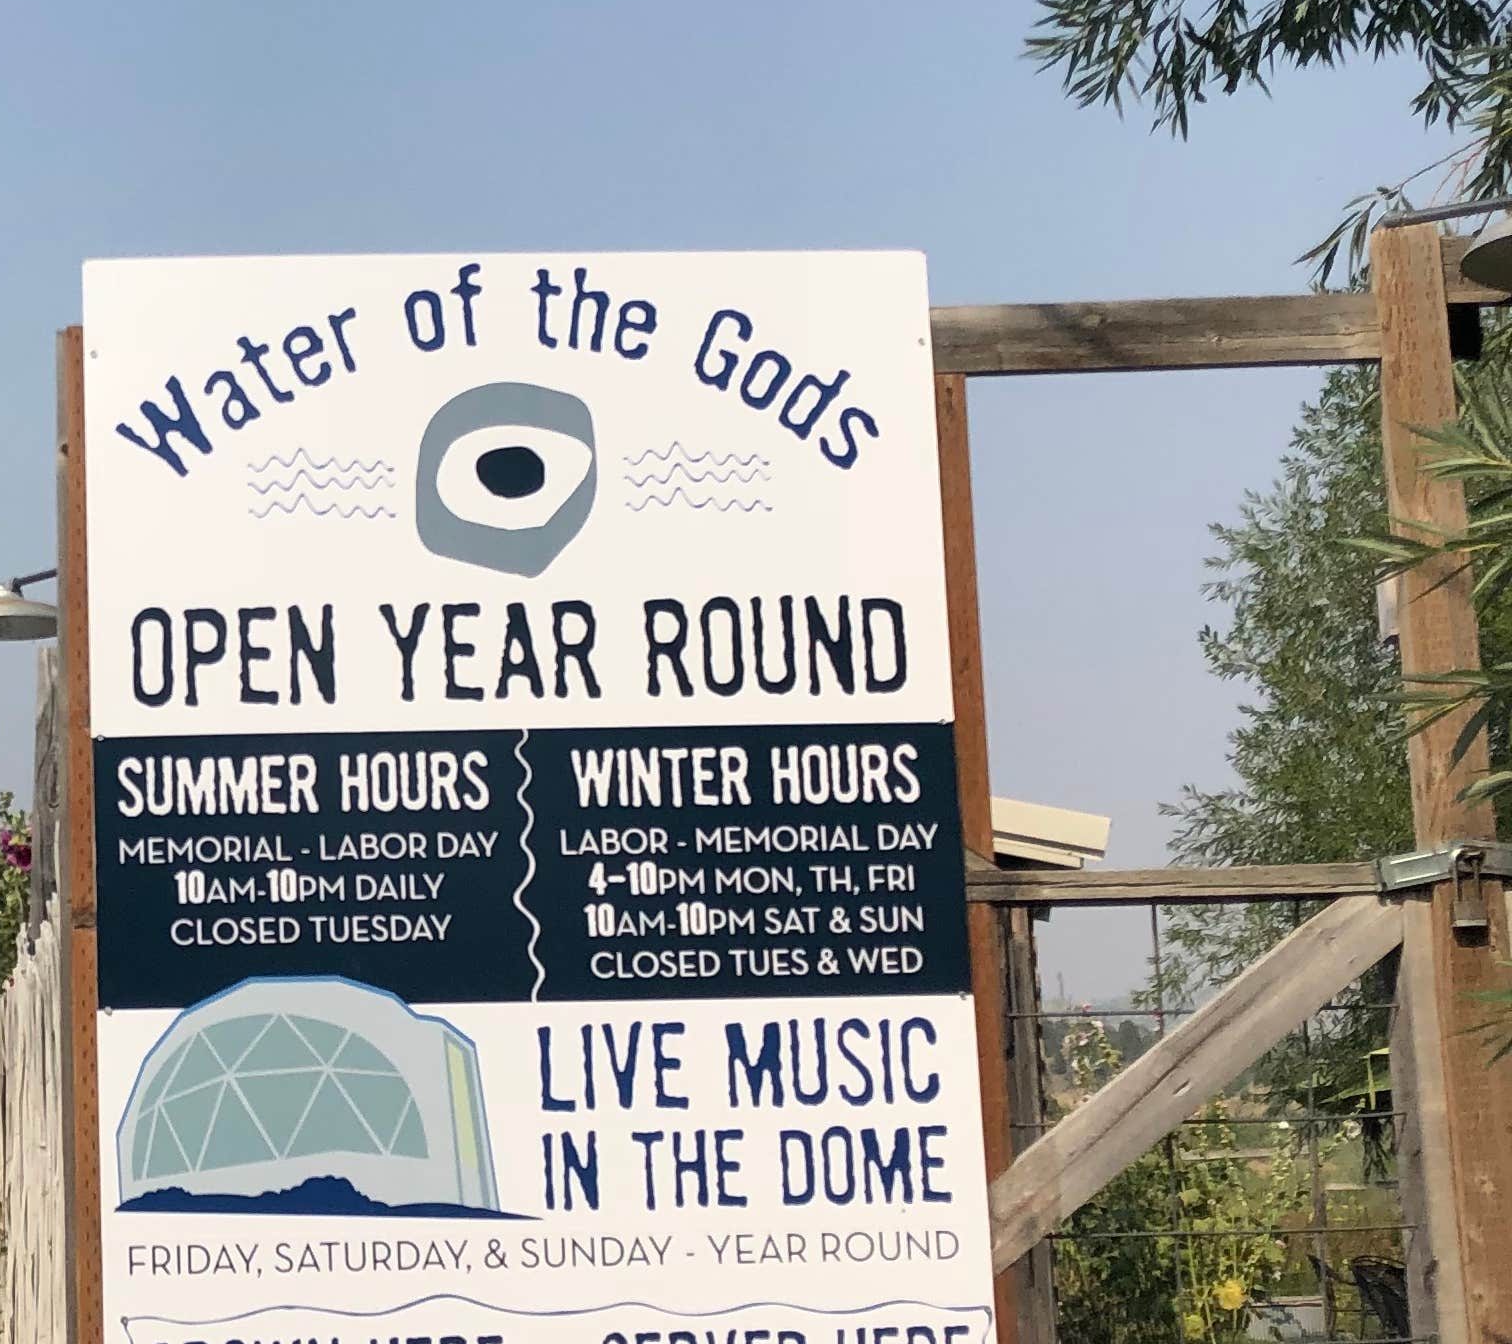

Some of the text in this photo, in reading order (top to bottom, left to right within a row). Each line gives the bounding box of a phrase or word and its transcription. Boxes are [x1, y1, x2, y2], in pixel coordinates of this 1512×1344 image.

[115, 262, 880, 478] Water of the Gods
[130, 594, 907, 708] OPEN YEAR ROUND
[117, 750, 490, 817] SUMMER HOURS
[570, 743, 921, 808] WINTER HOURS
[119, 835, 293, 865] MEMORIAL
[319, 832, 427, 861] LABOR
[437, 831, 499, 859] DAY
[560, 827, 668, 856] LABOR
[695, 824, 870, 853] MEMORIAL
[877, 823, 939, 851] DAY
[174, 867, 445, 905] 10AM-10PM DAILY
[588, 860, 915, 897] 4-10PM MON, TH, FRI
[170, 914, 452, 946] CLOSED TUESDAY
[583, 901, 924, 937] 10AM-10PM SAT & SUN
[590, 946, 923, 979] CLOSED TUES & WED
[537, 1016, 940, 1113] LIVE MUSIC
[541, 1125, 952, 1211] IN THE DOME
[128, 1243, 262, 1278] FRIDAY,
[274, 1239, 472, 1273] SATURDAY,
[484, 1238, 508, 1269] &
[521, 1235, 672, 1269] SUNDAY
[707, 1233, 807, 1265] YEAR
[821, 1230, 960, 1263] ROUND
